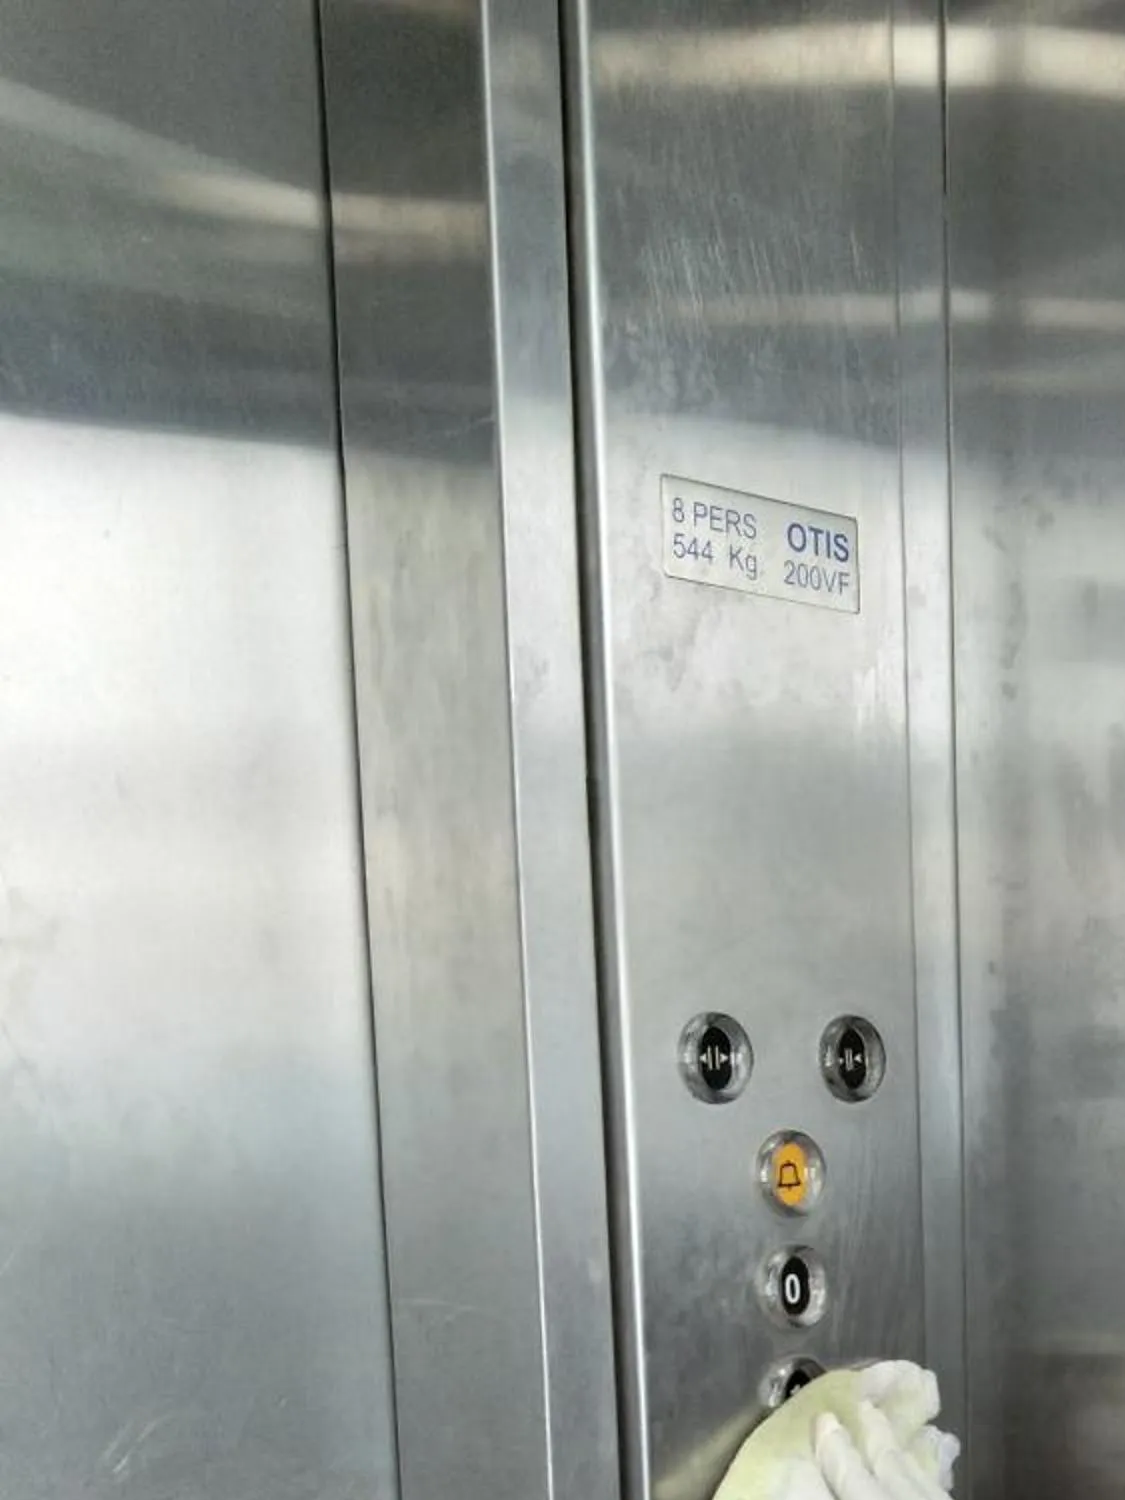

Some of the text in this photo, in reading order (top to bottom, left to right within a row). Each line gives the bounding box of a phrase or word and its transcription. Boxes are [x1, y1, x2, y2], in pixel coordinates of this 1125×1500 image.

[672, 497, 757, 540] 8 PERS
[672, 532, 757, 581] 544 Kg
[787, 522, 849, 563] OTIS
[784, 560, 850, 596] 200VF
[785, 1273, 801, 1304] 0
